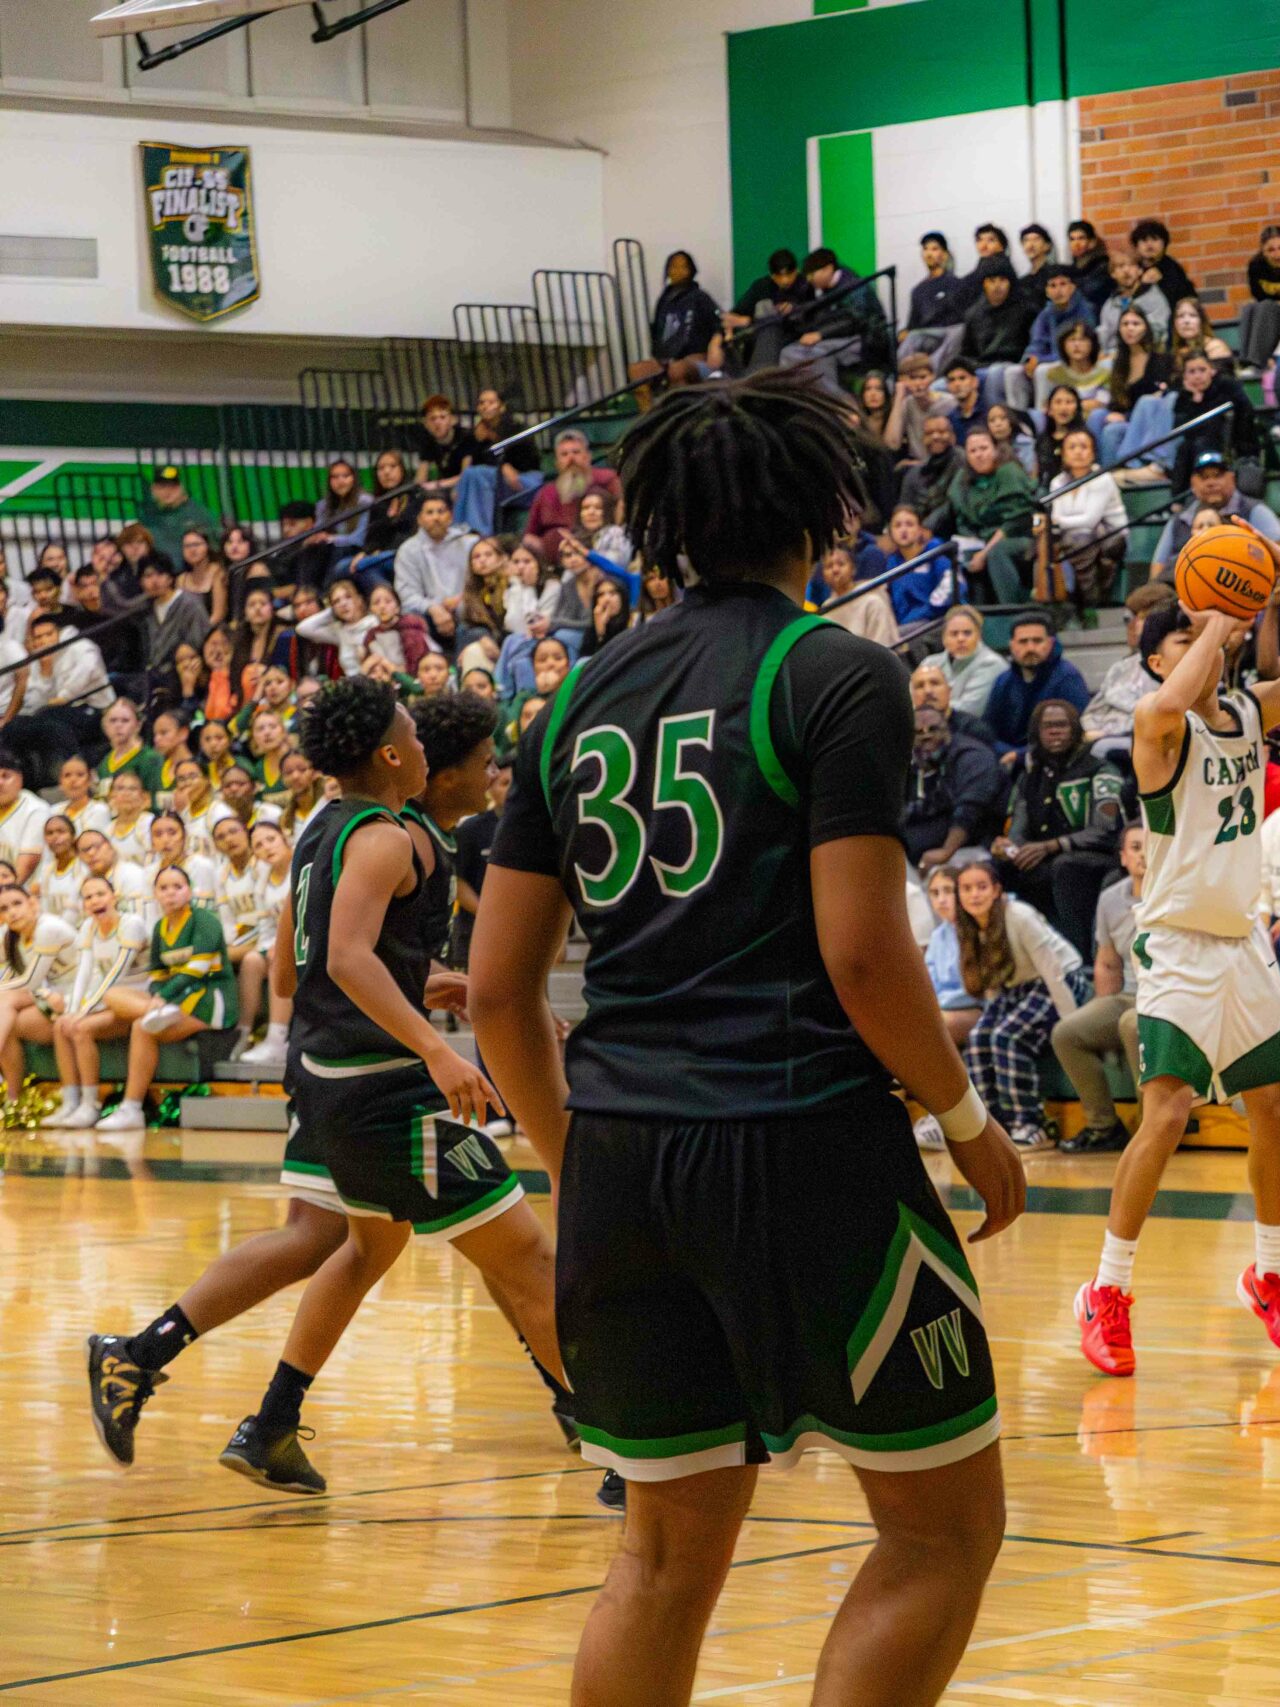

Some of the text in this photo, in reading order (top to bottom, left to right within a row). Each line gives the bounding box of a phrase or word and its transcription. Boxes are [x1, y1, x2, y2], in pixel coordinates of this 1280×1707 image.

[151, 188, 240, 228] FINALIST
[168, 263, 230, 294] 1988
[1215, 566, 1266, 604] Wilson
[570, 709, 724, 907] 35
